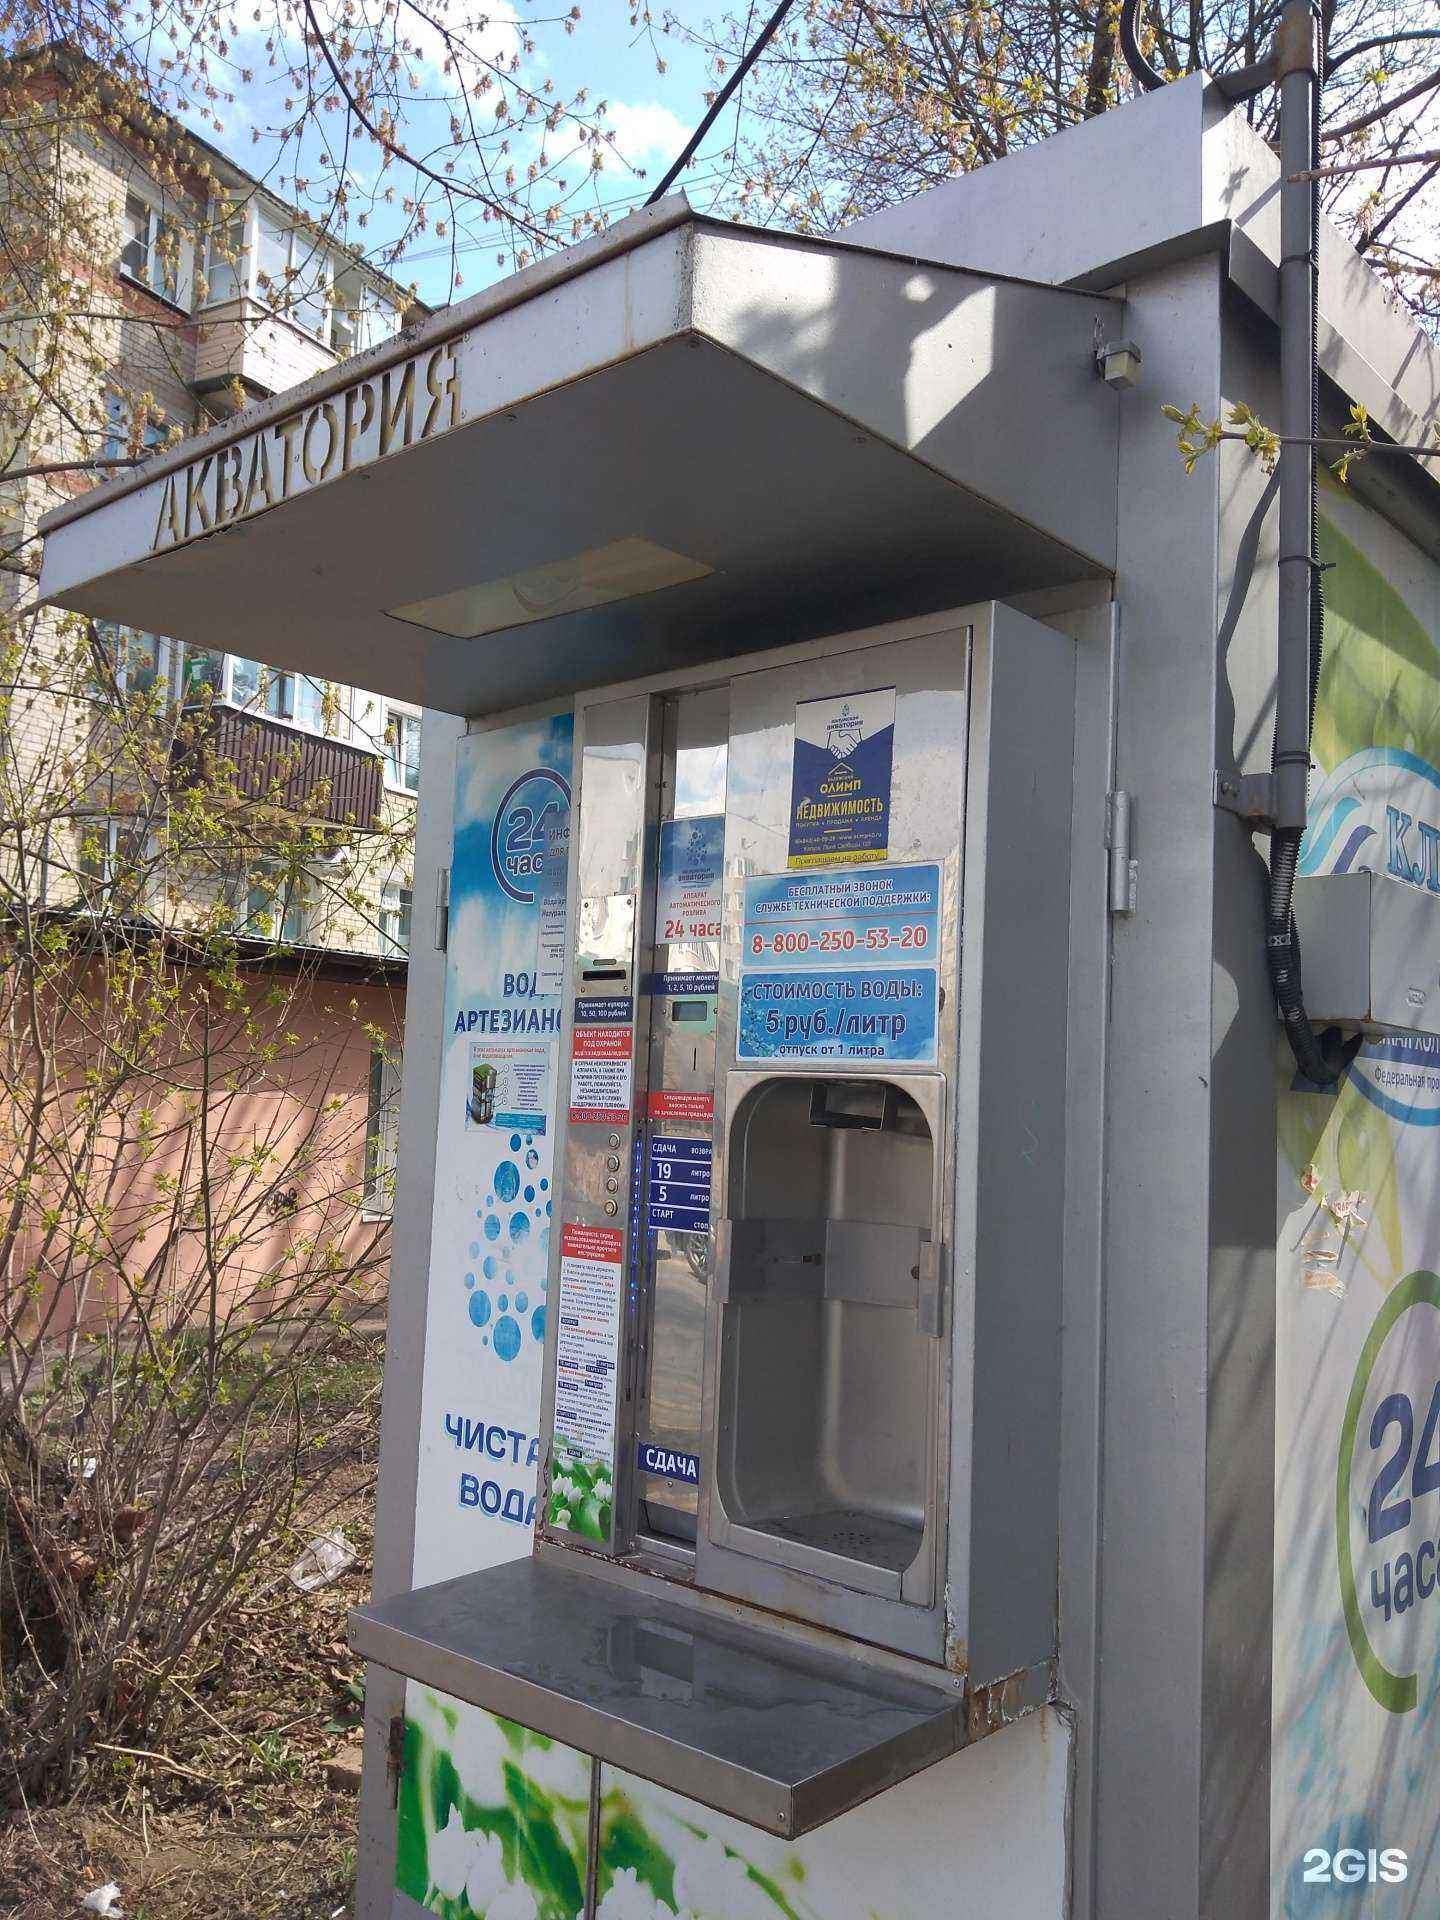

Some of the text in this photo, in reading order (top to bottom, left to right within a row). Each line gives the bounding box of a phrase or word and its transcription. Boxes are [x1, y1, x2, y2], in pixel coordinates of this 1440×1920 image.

[154, 343, 461, 550] АКВАТОРИЯ
[820, 780, 861, 794] ОЛИМП
[796, 797, 883, 820] НЕДВИЖИМОСТЬ
[788, 879, 893, 897] БЕСПЛАТНЫЙ ЗВОНОК
[756, 892, 931, 913] СЛУЖБЕ ТЕХНИЧЕСКОЙ ПОДДЕРЖКИ:
[665, 920, 684, 938] 24
[752, 926, 927, 953] 8-800-250-53-20
[664, 975, 696, 983] Принимает
[694, 983, 715, 992] рублей
[753, 981, 922, 999] СТОИМОСТЬ ВОДЫ:
[578, 1001, 607, 1009] Принимает
[766, 1008, 906, 1040] 5 руб./литр
[597, 1030, 631, 1038] НАХОДИТСЯ
[780, 1045, 885, 1058] отпуск от 1 литра
[1375, 1064, 1425, 1088] Федеральная
[652, 1143, 677, 1153] СДАЧА
[657, 1163, 671, 1179] 19
[659, 1186, 666, 1201] 5
[652, 1209, 674, 1219] СТАРТ
[446, 1413, 539, 1466] ЧИСТА
[646, 1449, 697, 1478] СДАЧА
[1371, 1540, 1440, 1620] час
